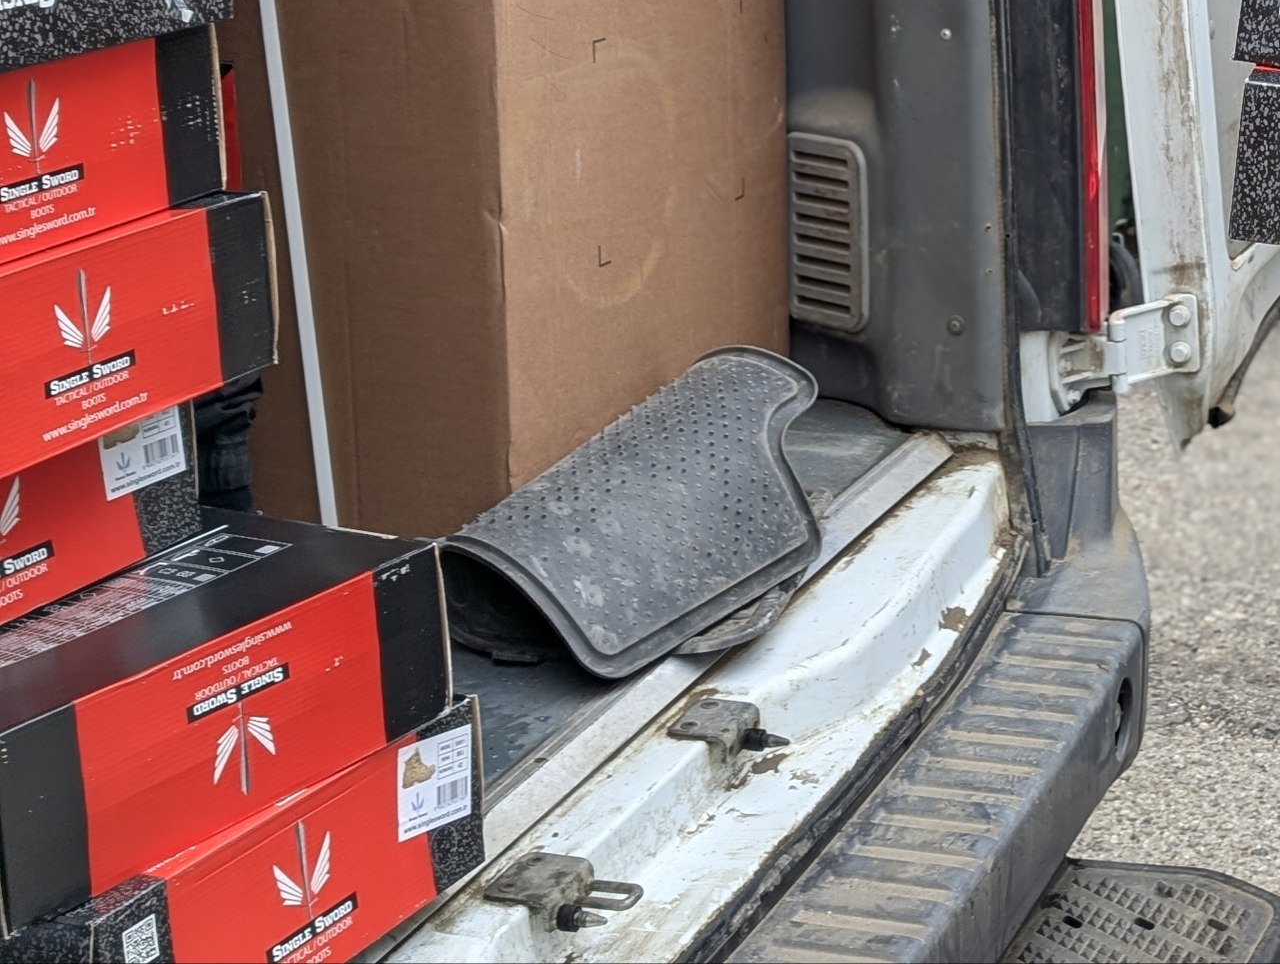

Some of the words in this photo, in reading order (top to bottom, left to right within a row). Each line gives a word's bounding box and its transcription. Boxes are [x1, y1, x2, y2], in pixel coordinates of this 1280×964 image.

[0, 181, 39, 202] SINGLE
[42, 169, 79, 189] SWORD
[4, 194, 38, 214] TACTICAL
[42, 183, 78, 202] OUTDOOR
[31, 204, 55, 220] BOOTS
[50, 372, 90, 396] SINGLE
[92, 356, 131, 379] SWORD
[55, 386, 88, 406] TACTICAL
[93, 370, 130, 391] OUTDOOR
[82, 392, 107, 410] BOOTS
[43, 392, 148, 442] www.singlesword.com.tr
[3, 547, 48, 575] SWORD
[6, 563, 49, 588] OUTDOOR
[0, 588, 24, 606] OOTS
[172, 621, 293, 681] www.singlesword.com.tr
[222, 656, 250, 675] BOOTS
[242, 657, 279, 678] TACTICAL
[194, 675, 237, 701] OUTDOOR
[241, 667, 284, 695] SINGLE
[192, 687, 238, 716] SWORD
[272, 927, 313, 962] SINGLE
[315, 900, 353, 934] SWORD
[316, 915, 353, 948] OUTDOOR
